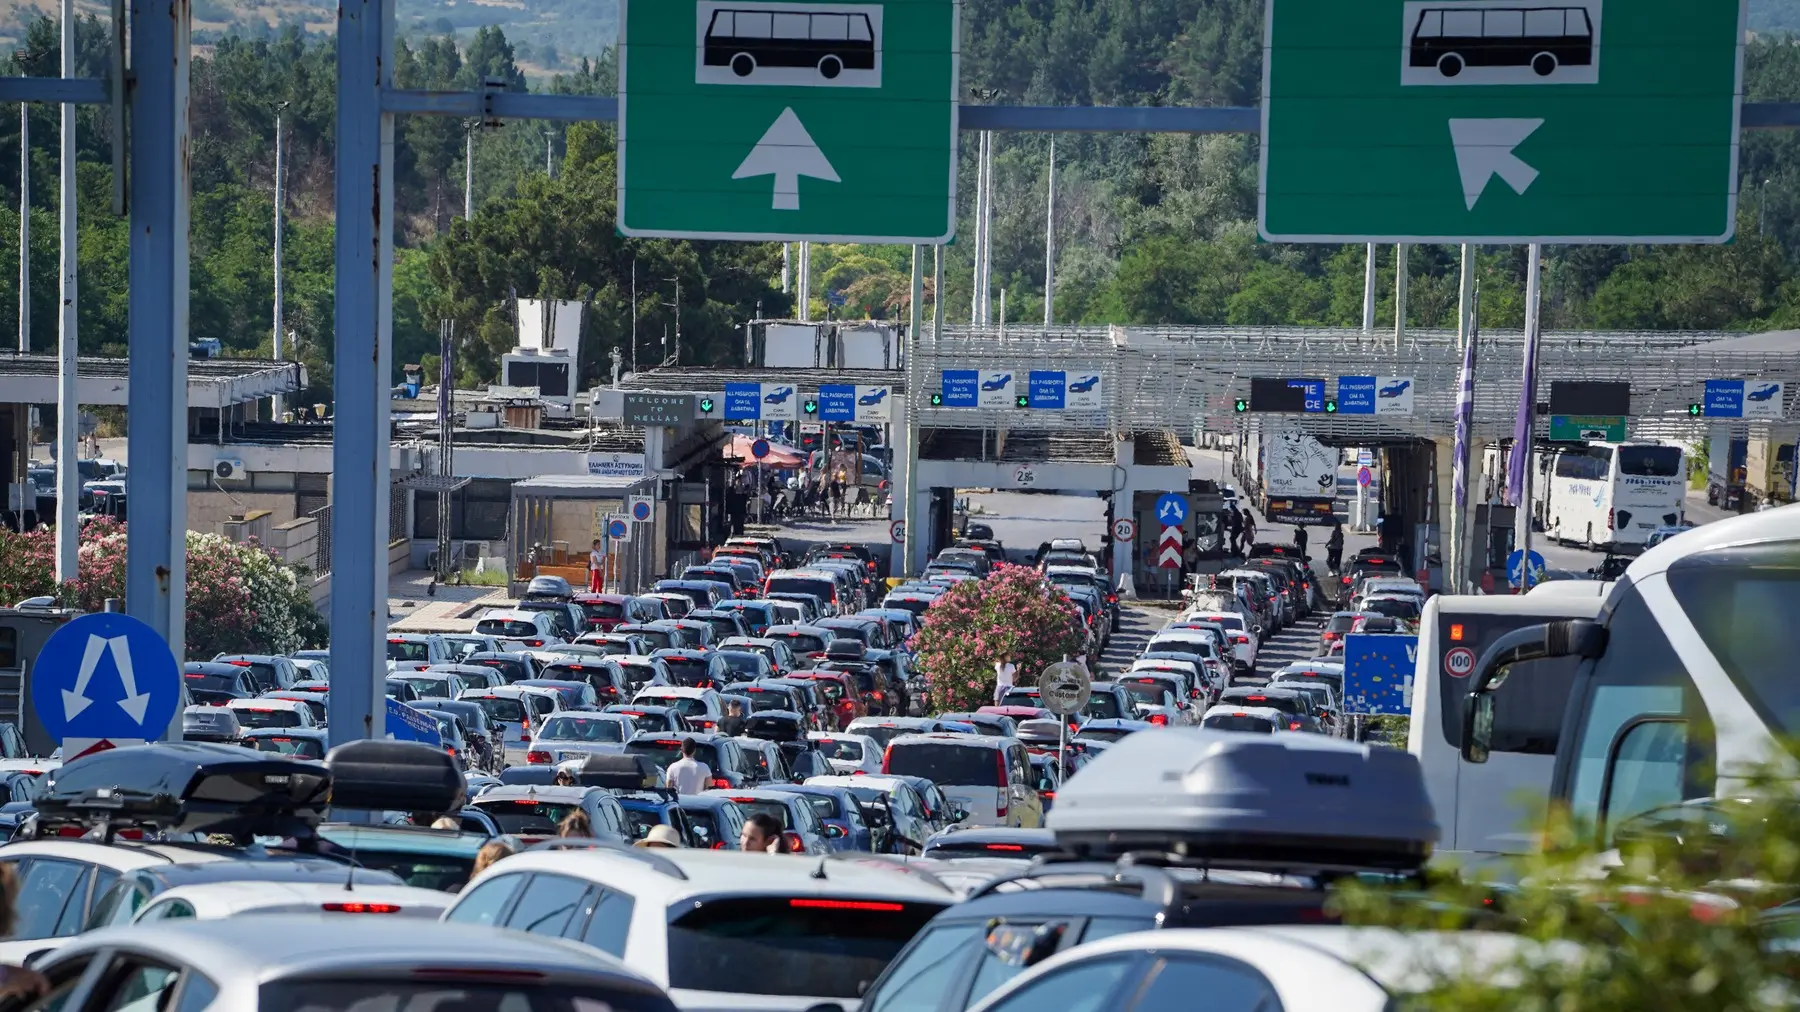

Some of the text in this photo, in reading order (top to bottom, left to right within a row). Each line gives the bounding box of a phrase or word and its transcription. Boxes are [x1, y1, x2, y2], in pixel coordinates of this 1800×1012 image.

[629, 396, 684, 404] WELCOME
[1118, 525, 1130, 534] 20
[1452, 656, 1470, 667] 100
